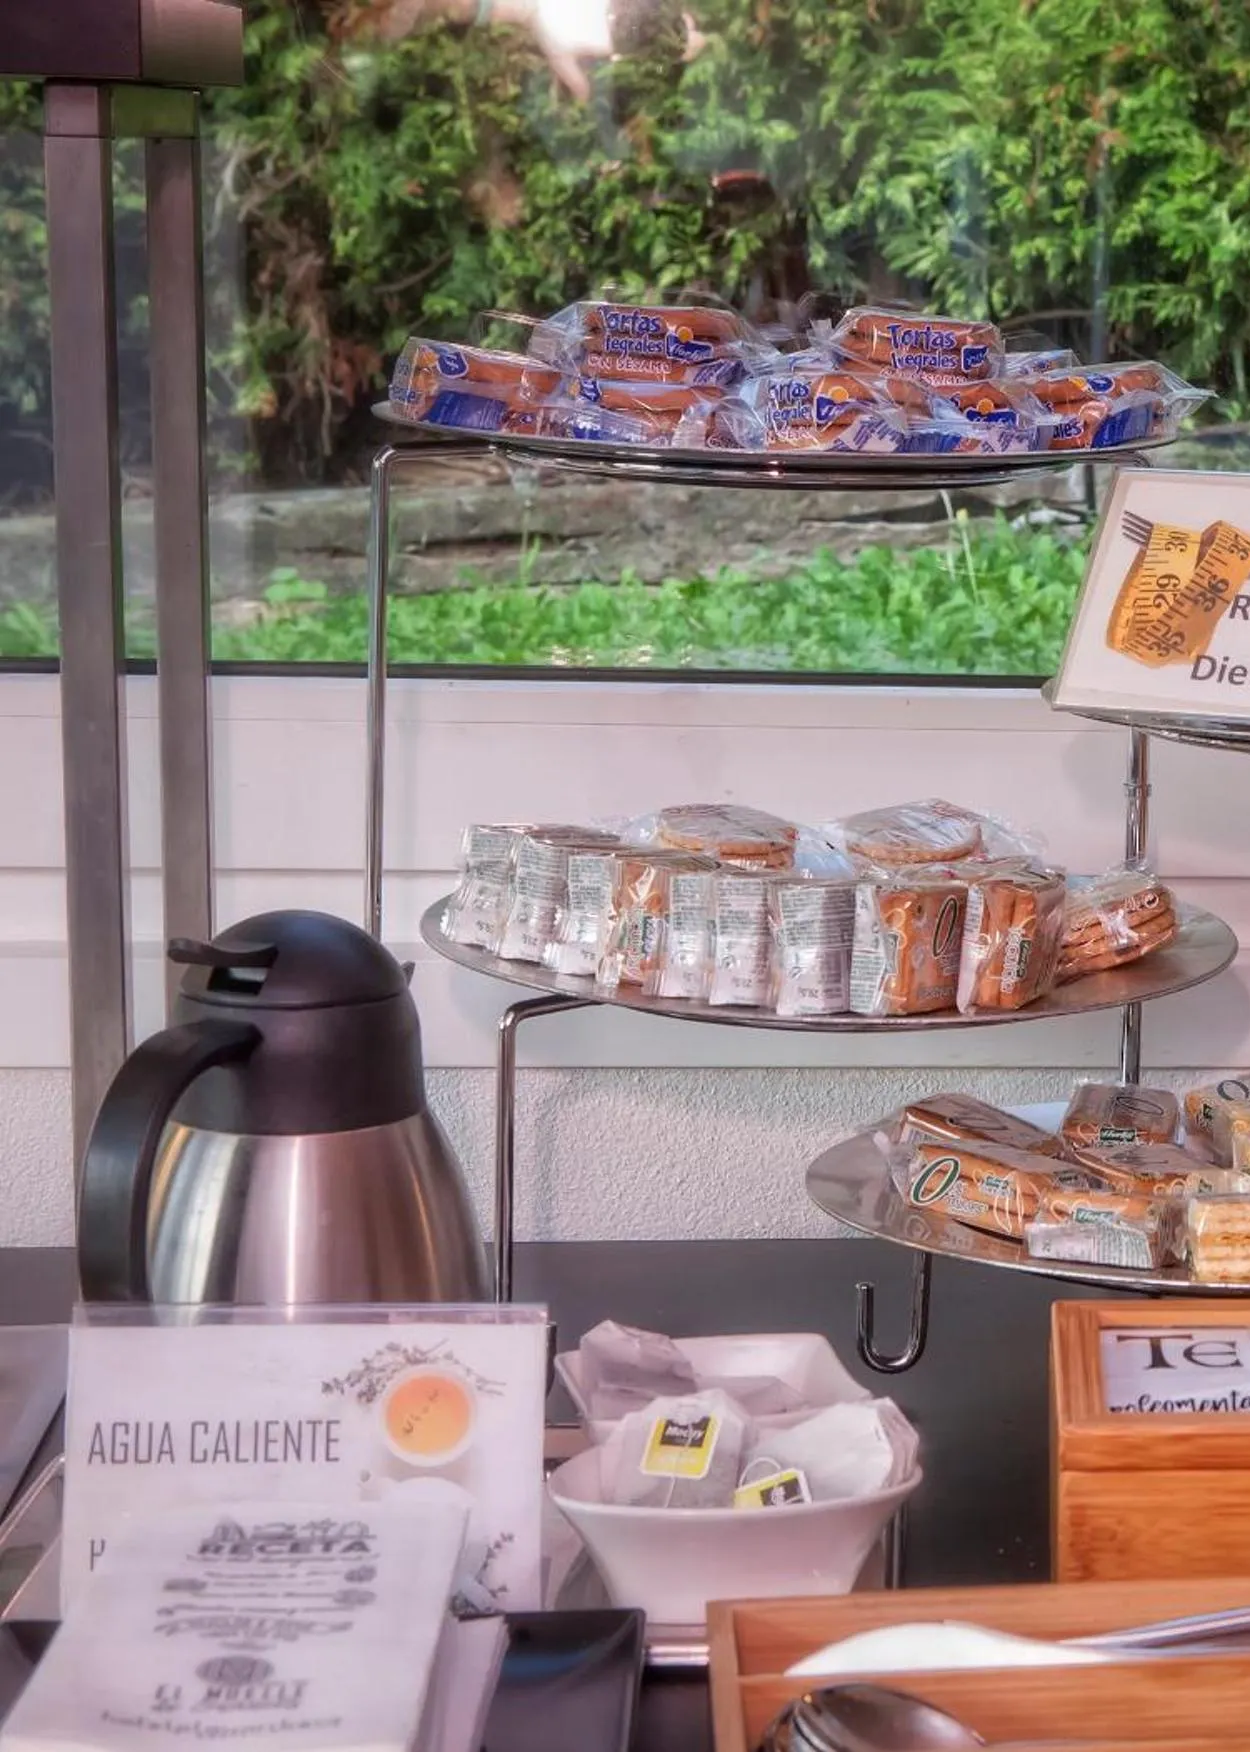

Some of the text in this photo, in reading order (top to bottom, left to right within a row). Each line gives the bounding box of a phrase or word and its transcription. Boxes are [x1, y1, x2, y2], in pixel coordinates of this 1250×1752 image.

[887, 323, 958, 351] Tortas
[87, 1419, 342, 1466] AGUA CALIENTE
